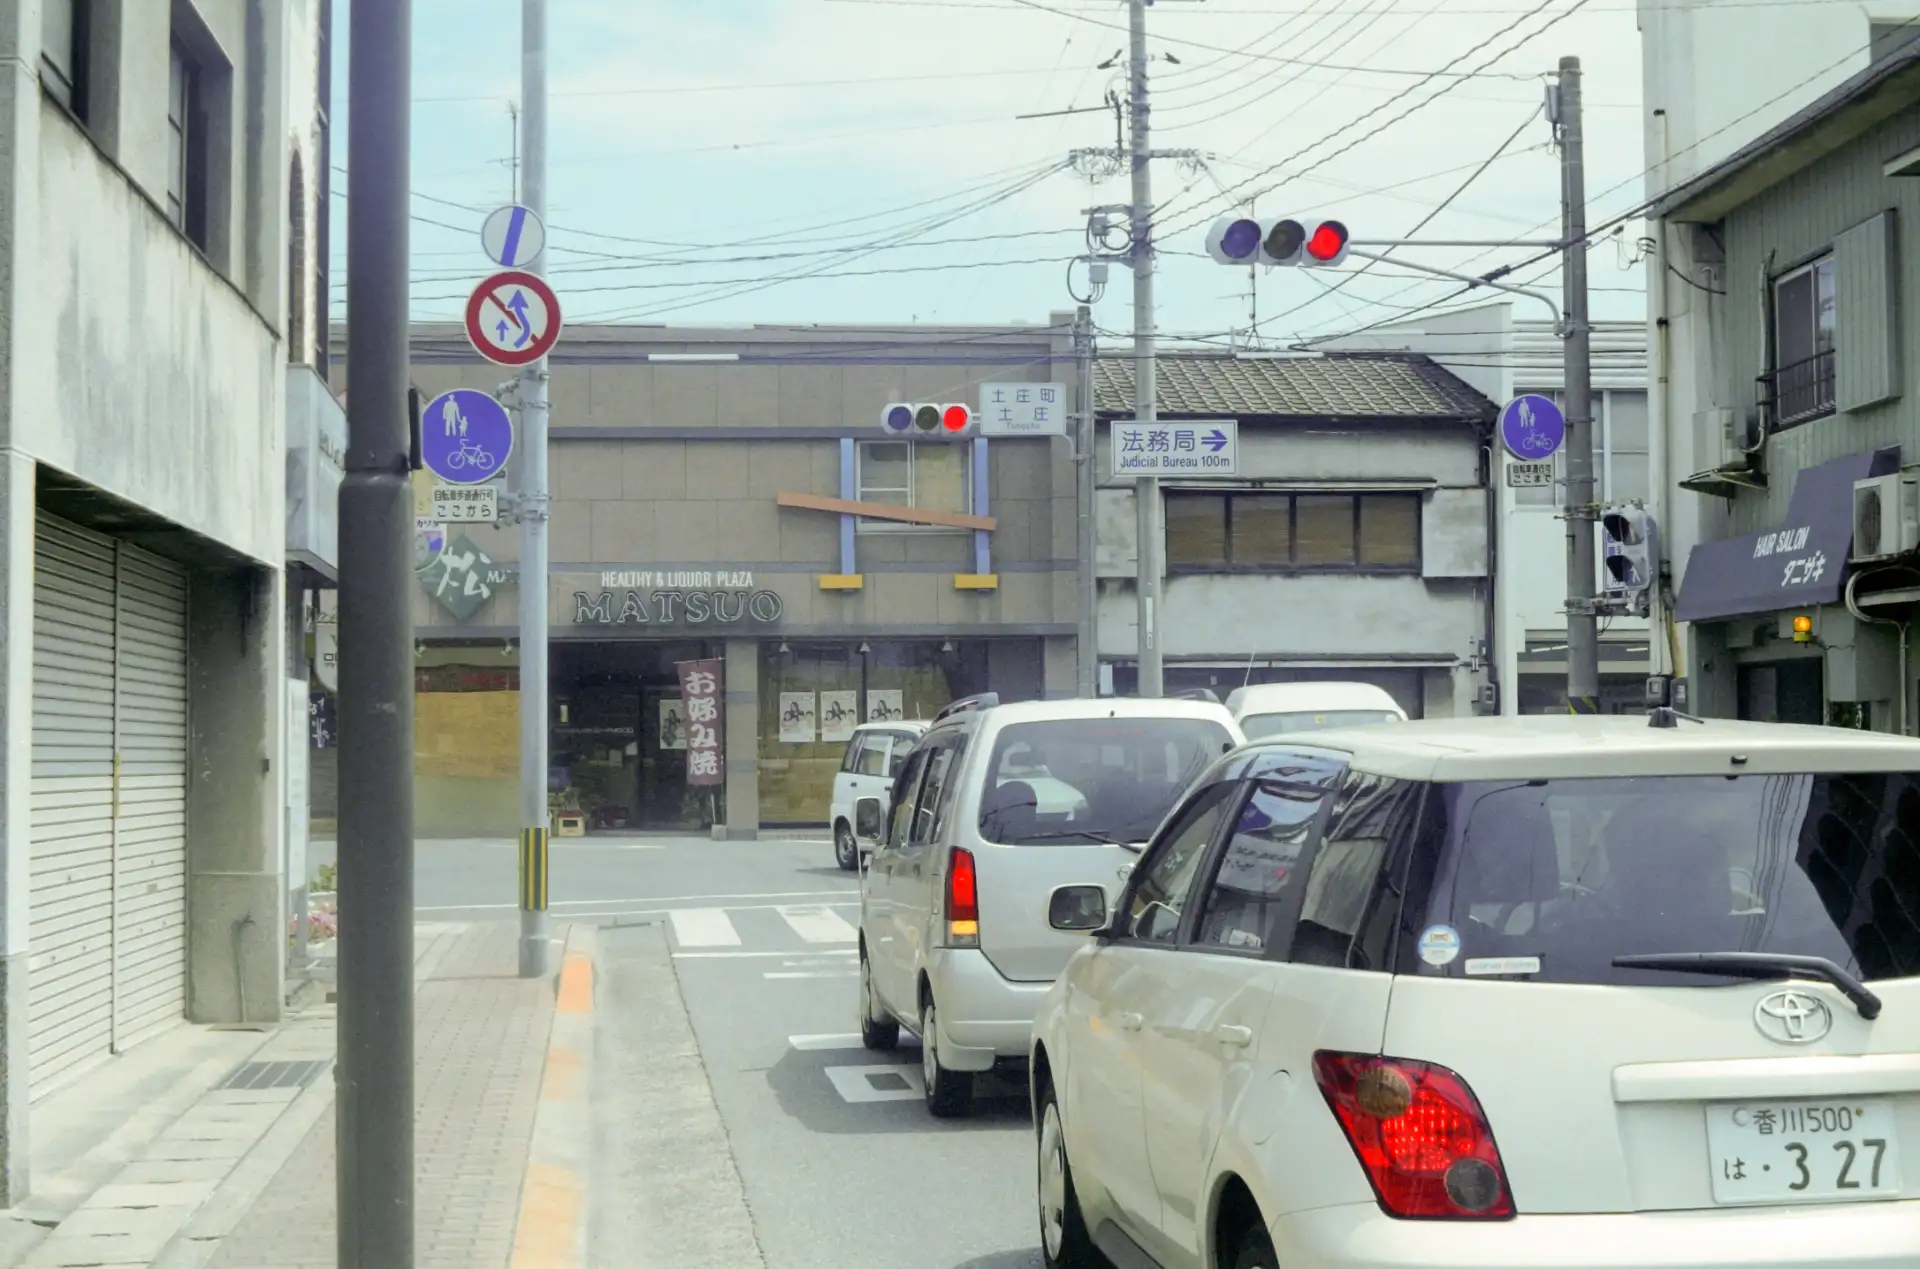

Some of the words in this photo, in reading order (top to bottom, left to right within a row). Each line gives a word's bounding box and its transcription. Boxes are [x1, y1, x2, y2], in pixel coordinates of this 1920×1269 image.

[991, 388, 1055, 403] 土庄町
[998, 407, 1049, 421] 土庄
[1122, 430, 1195, 452] 法務局
[1121, 456, 1158, 468] Judicial
[1163, 456, 1198, 467] Bureau
[1201, 456, 1230, 467] 100m
[1513, 475, 1551, 483] ここまで
[437, 504, 491, 517] ここから
[1753, 533, 1777, 558] HAIR
[1776, 526, 1810, 553] SALON
[601, 571, 651, 587] HEALTHY
[656, 572, 664, 586] &
[668, 571, 711, 587] LIQUOR
[716, 571, 753, 587] PLAZA
[573, 590, 783, 623] MATSUO
